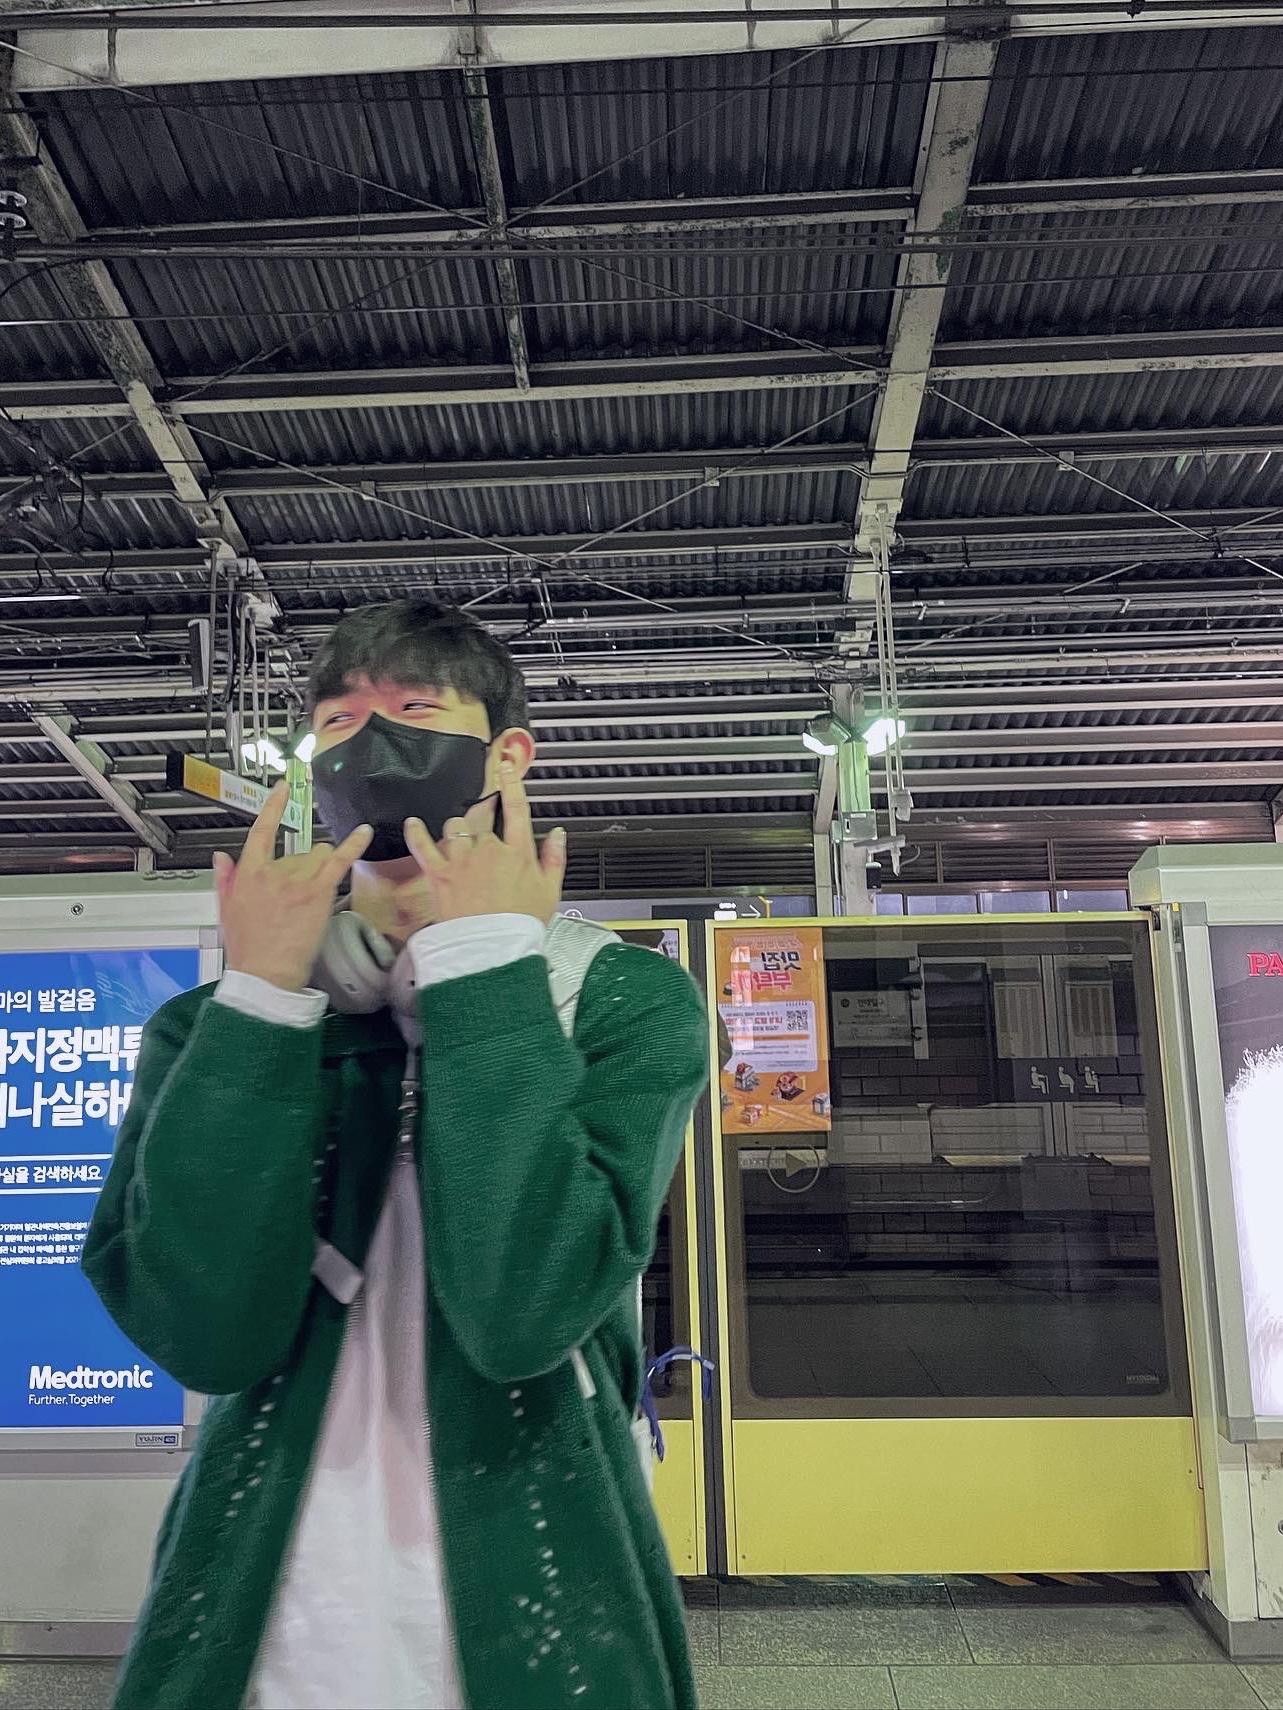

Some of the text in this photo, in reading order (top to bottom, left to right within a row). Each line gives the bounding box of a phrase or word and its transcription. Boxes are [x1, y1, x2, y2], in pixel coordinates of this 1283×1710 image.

[38, 988, 96, 1012] 발걸음
[0, 1079, 133, 1128] 나실하
[0, 1164, 103, 1184] 실을 검색하세요
[29, 1364, 153, 1390] Medtronic
[69, 1393, 115, 1407] Together
